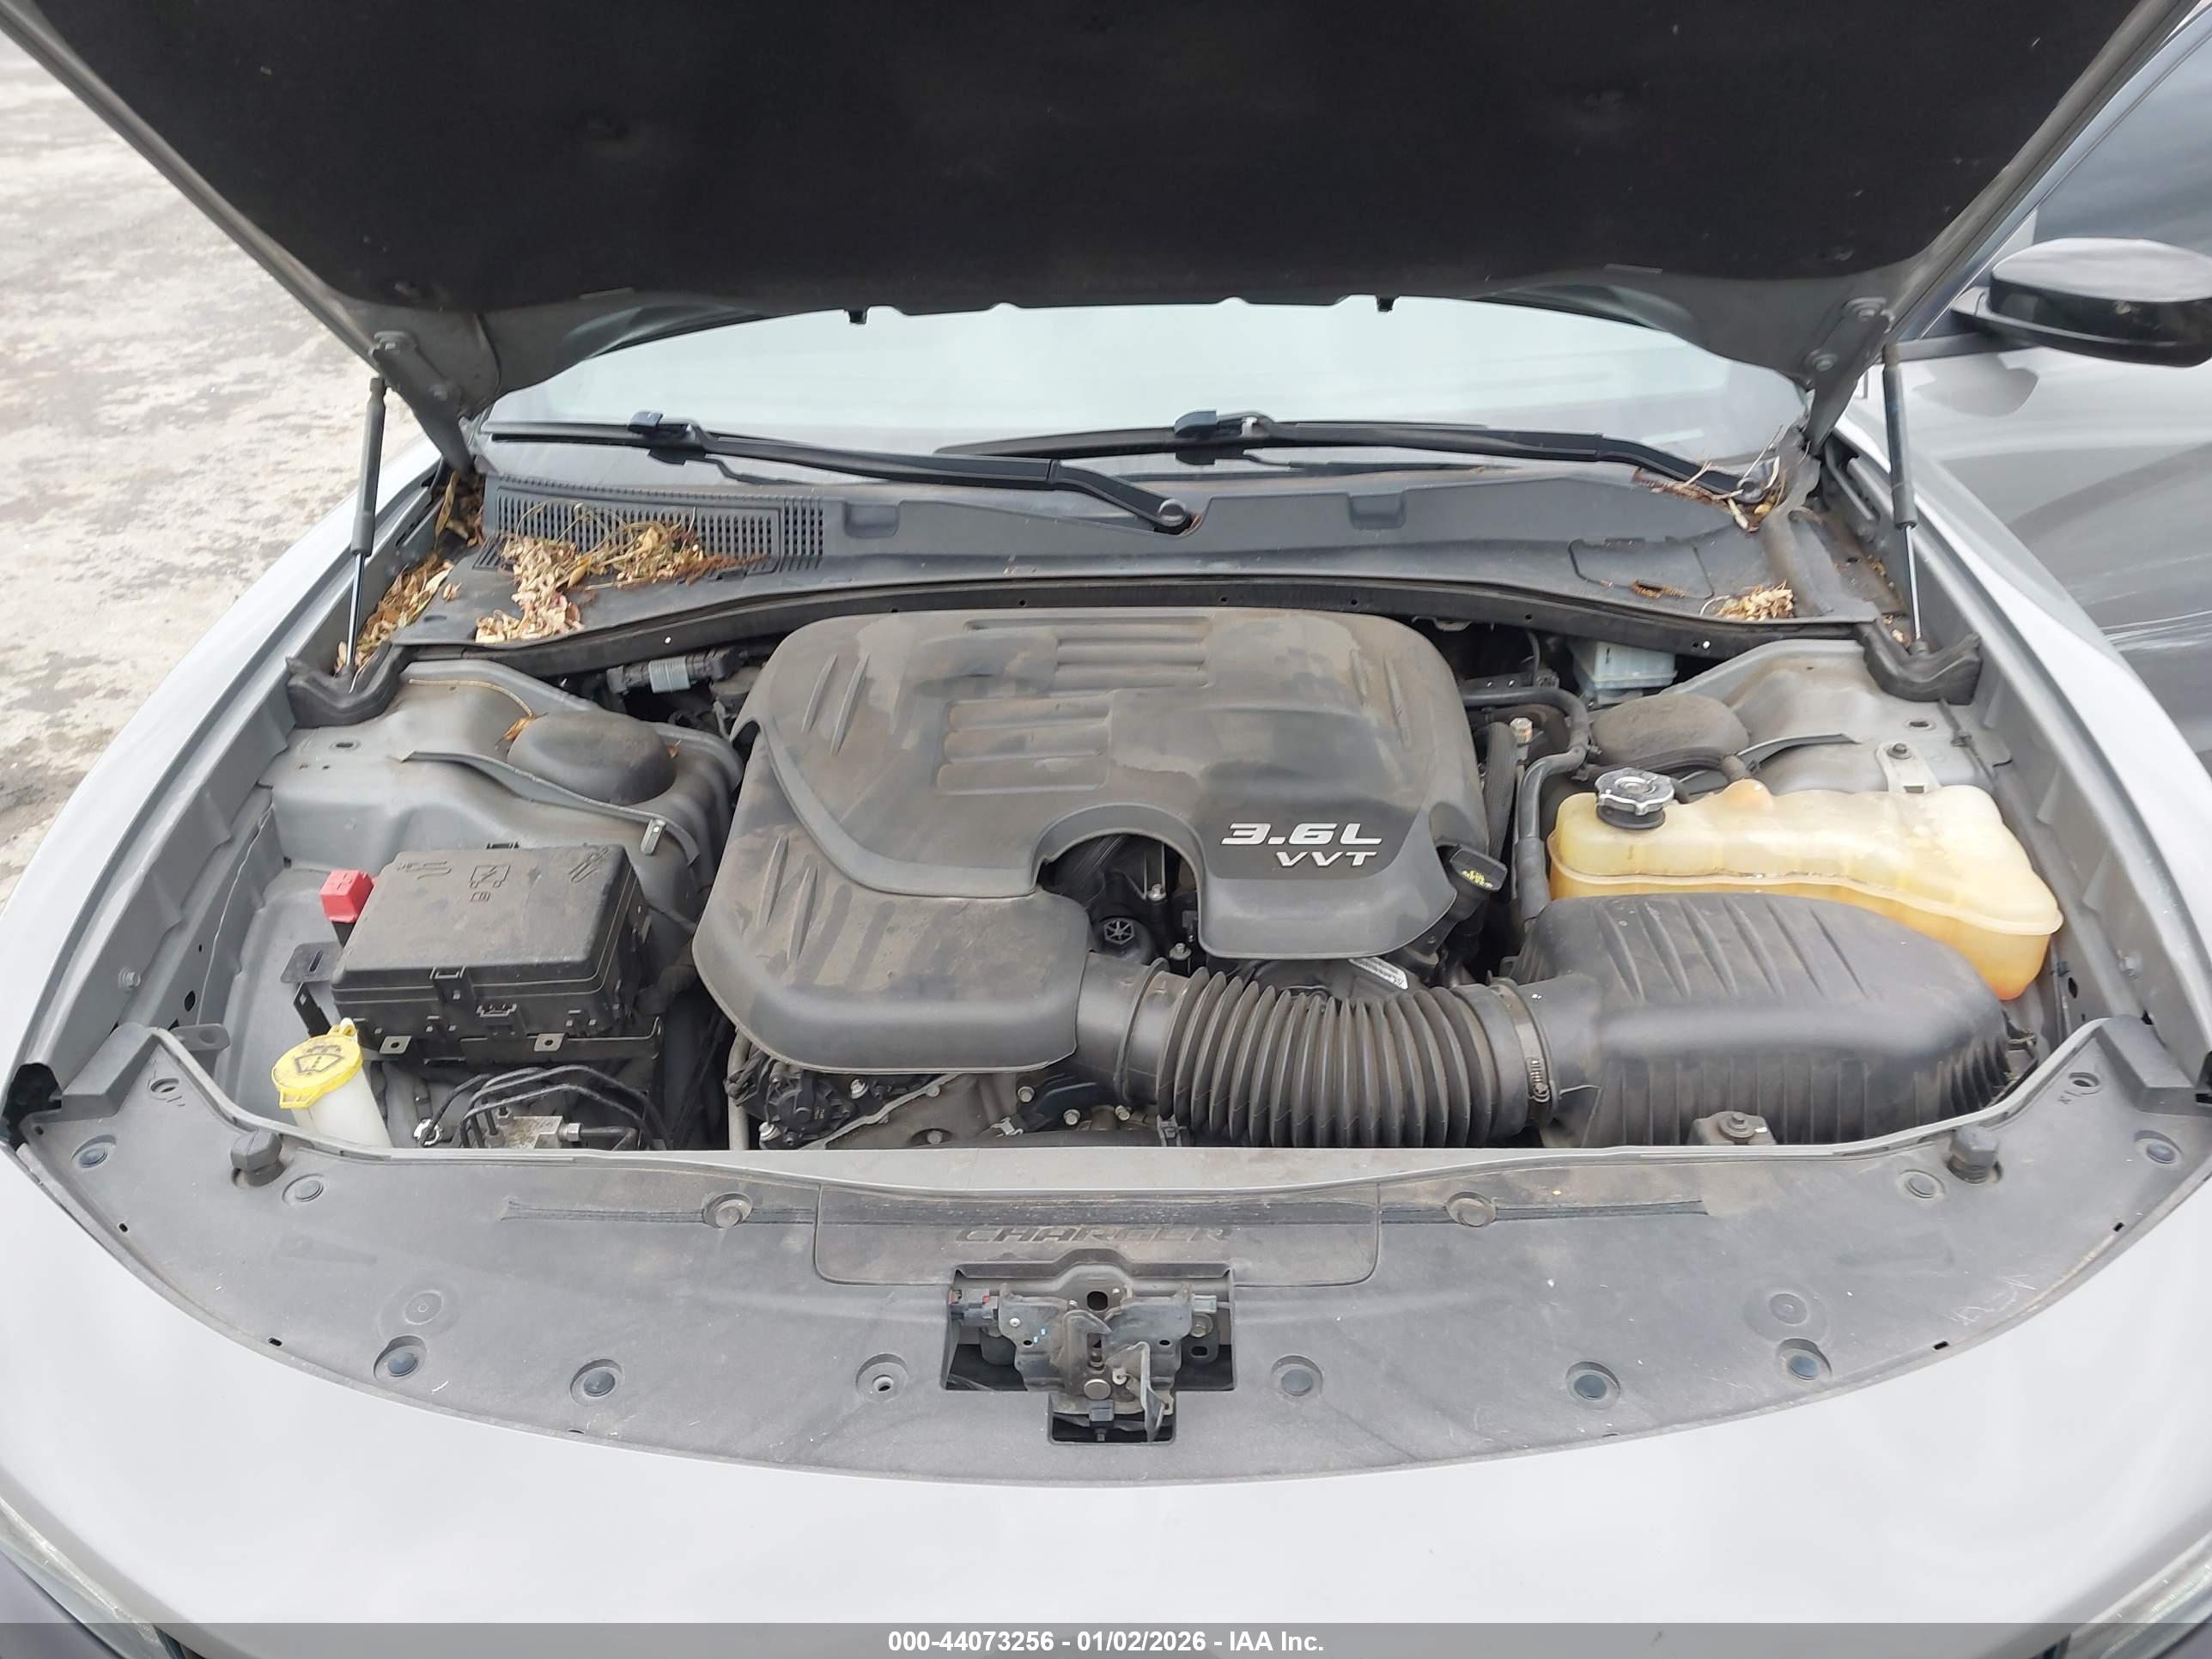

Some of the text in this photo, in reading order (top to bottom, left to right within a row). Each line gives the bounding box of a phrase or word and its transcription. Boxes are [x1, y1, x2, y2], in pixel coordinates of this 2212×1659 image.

[1220, 822, 1383, 846] 3.6L
[1275, 850, 1378, 867] VVT
[955, 1224, 1232, 1243] CHARGER
